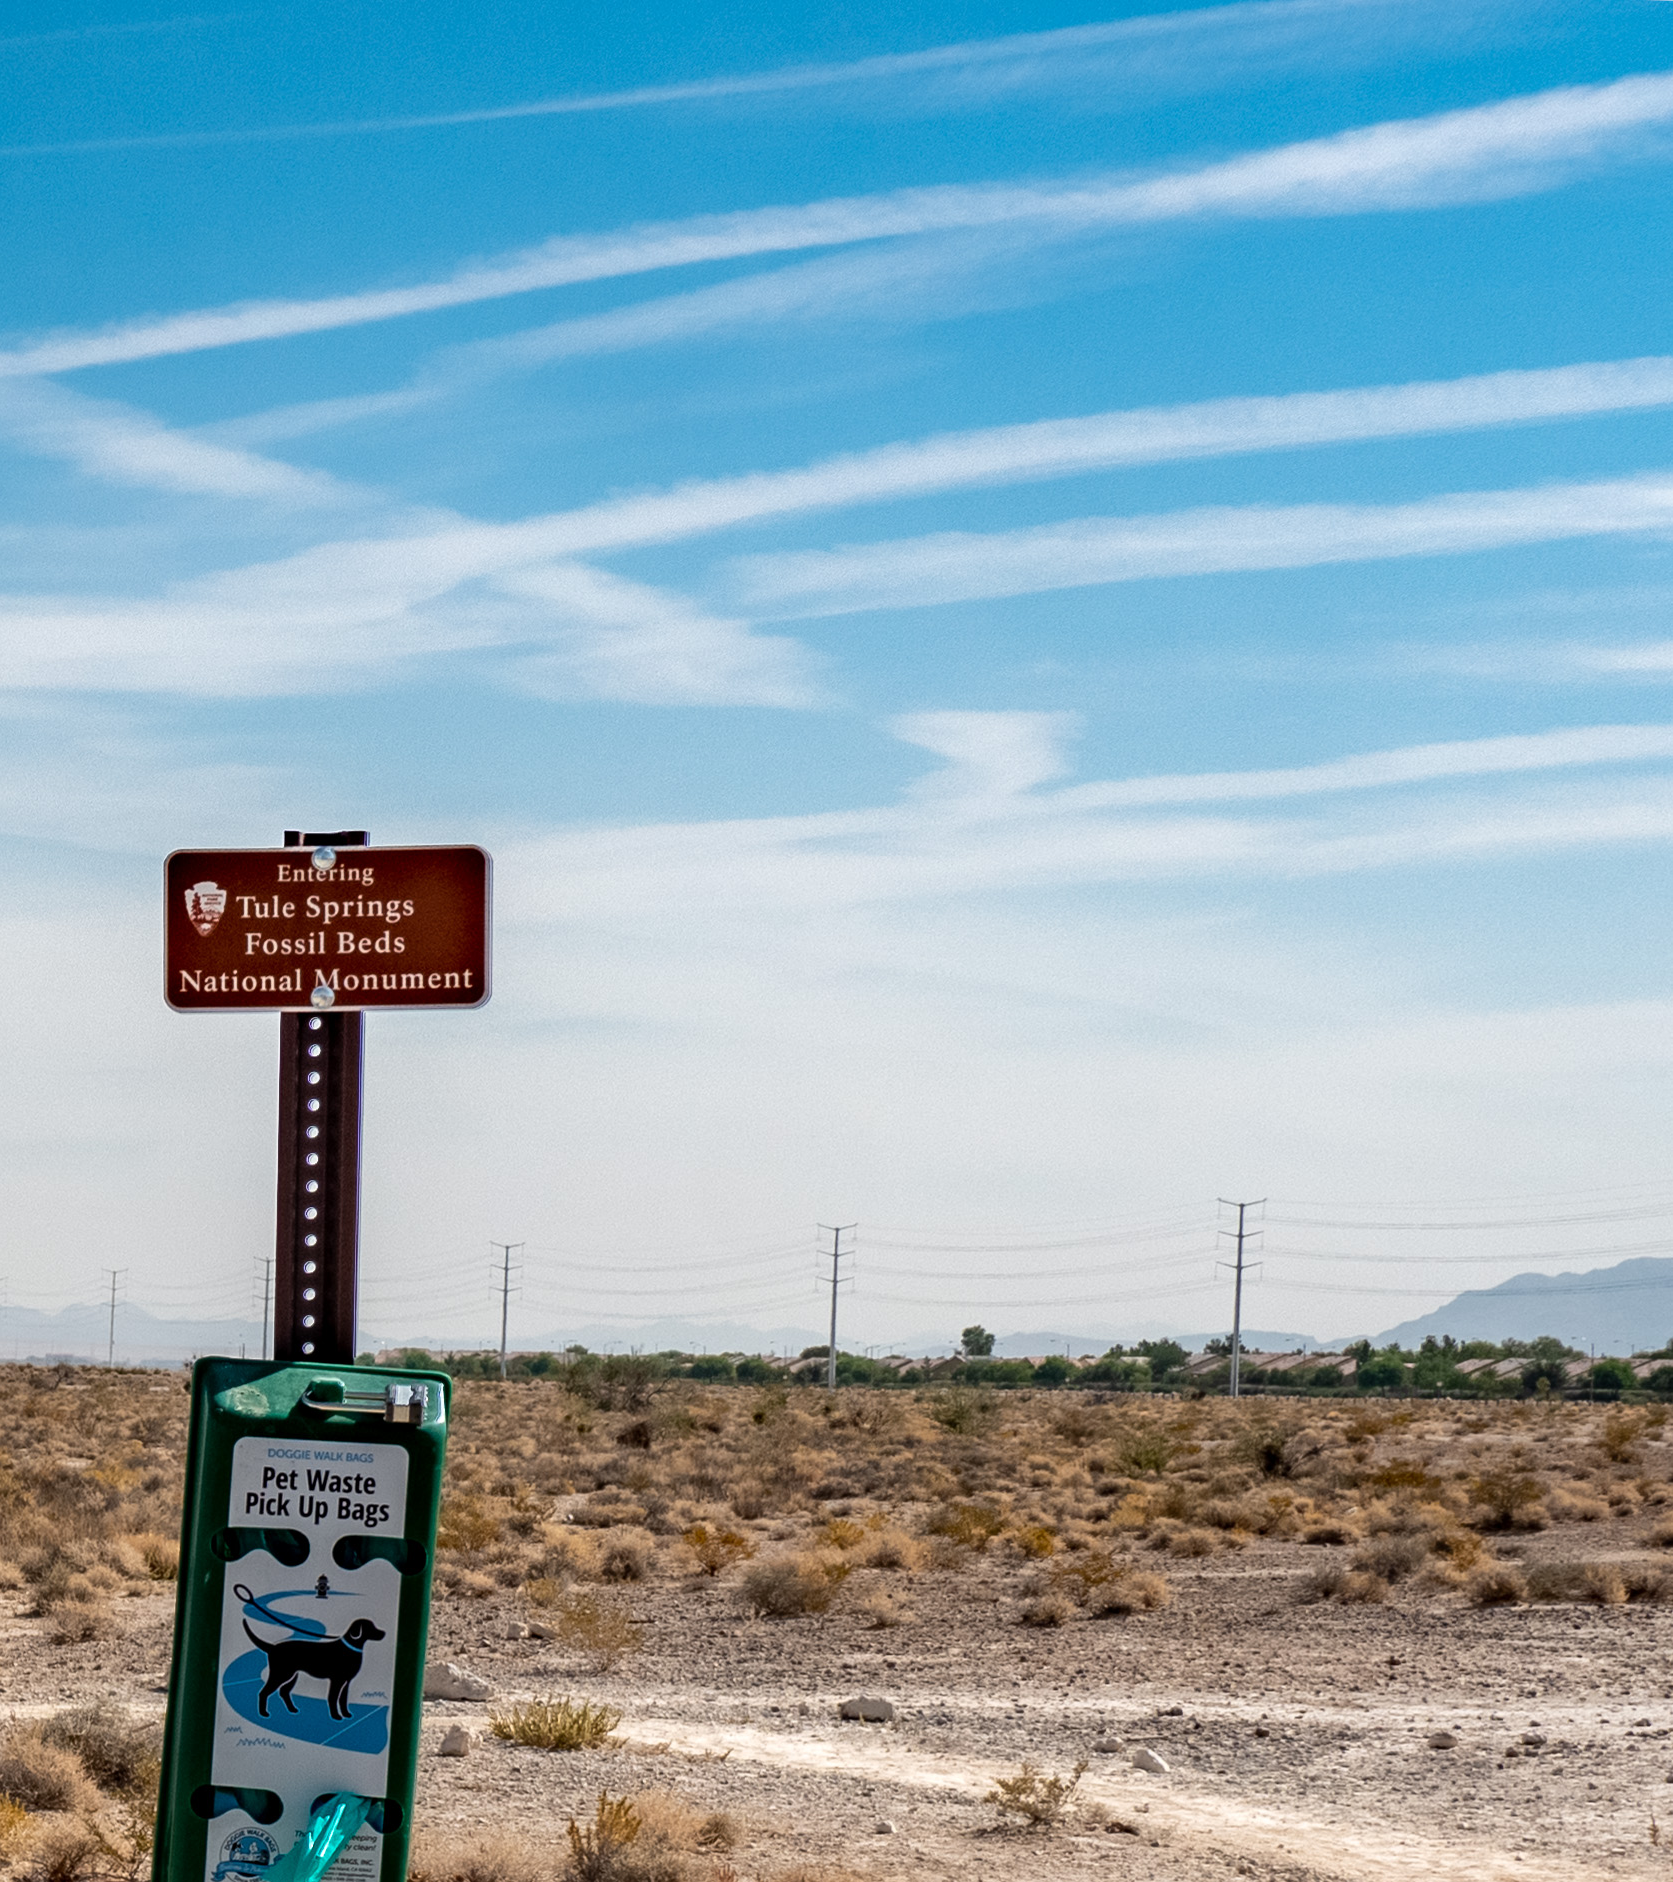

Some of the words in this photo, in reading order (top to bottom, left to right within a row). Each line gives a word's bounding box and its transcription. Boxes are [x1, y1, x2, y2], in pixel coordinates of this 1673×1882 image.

[277, 864, 374, 886] Entering
[236, 896, 295, 918] Tule
[306, 895, 415, 924] Springs
[245, 932, 325, 955] Fossil
[337, 931, 405, 954] Beds
[179, 968, 302, 992] National
[314, 968, 473, 990] Monument
[267, 1448, 311, 1460] DOGGIE
[314, 1451, 343, 1461] WALK
[346, 1453, 374, 1463] BAGS
[262, 1466, 298, 1490] Pet
[307, 1468, 376, 1494] Waste
[245, 1492, 290, 1517] Pick
[299, 1495, 329, 1525] Up
[337, 1497, 390, 1528] Bags
[224, 1830, 245, 1850] DOGGIE
[247, 1830, 264, 1838] WALK
[264, 1836, 277, 1852] BAGS
